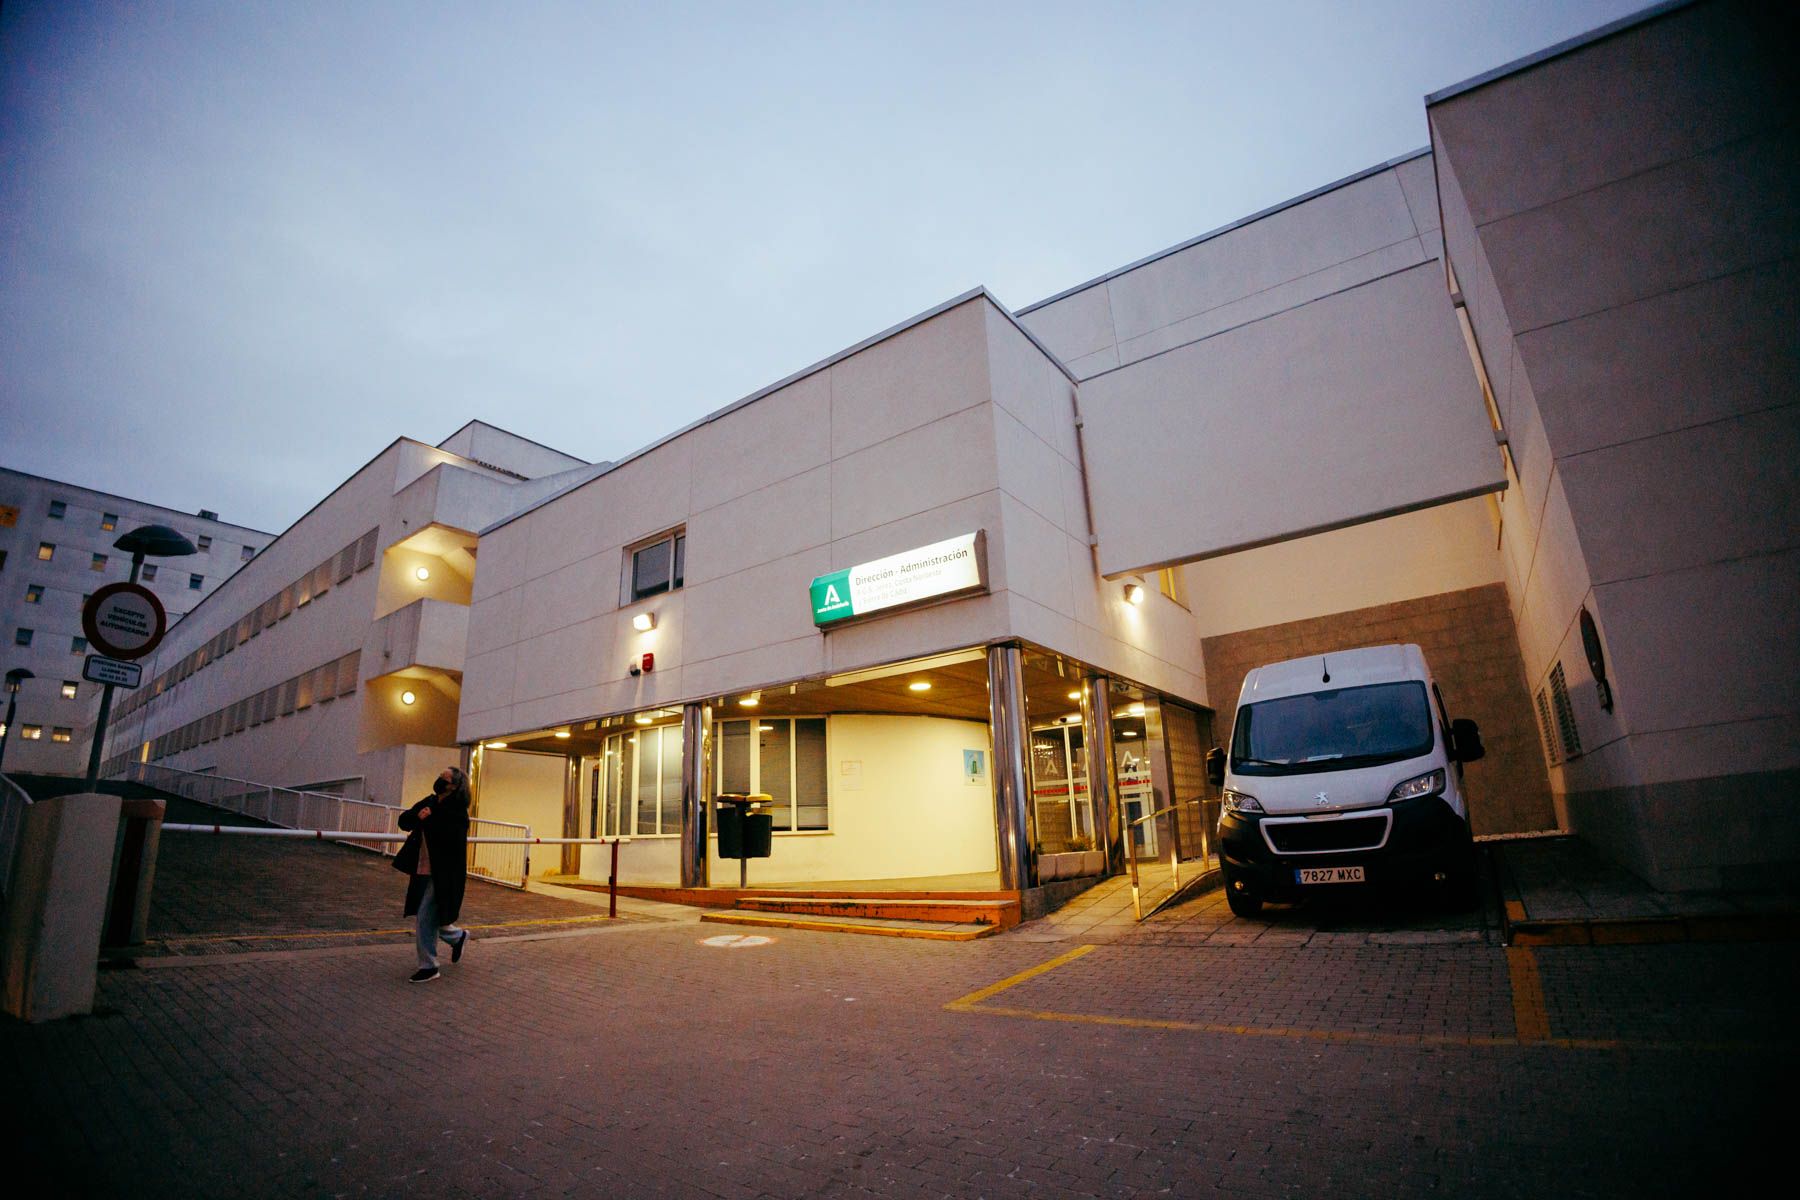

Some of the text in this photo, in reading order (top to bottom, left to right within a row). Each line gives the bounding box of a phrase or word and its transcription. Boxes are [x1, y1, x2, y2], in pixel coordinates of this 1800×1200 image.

[856, 569, 894, 586] Dirección
[900, 549, 968, 573] Administración
[113, 606, 145, 619] EXCEPTO
[100, 620, 149, 637] AUTORIZADOS
[1303, 868, 1361, 882] 7827 MXC
